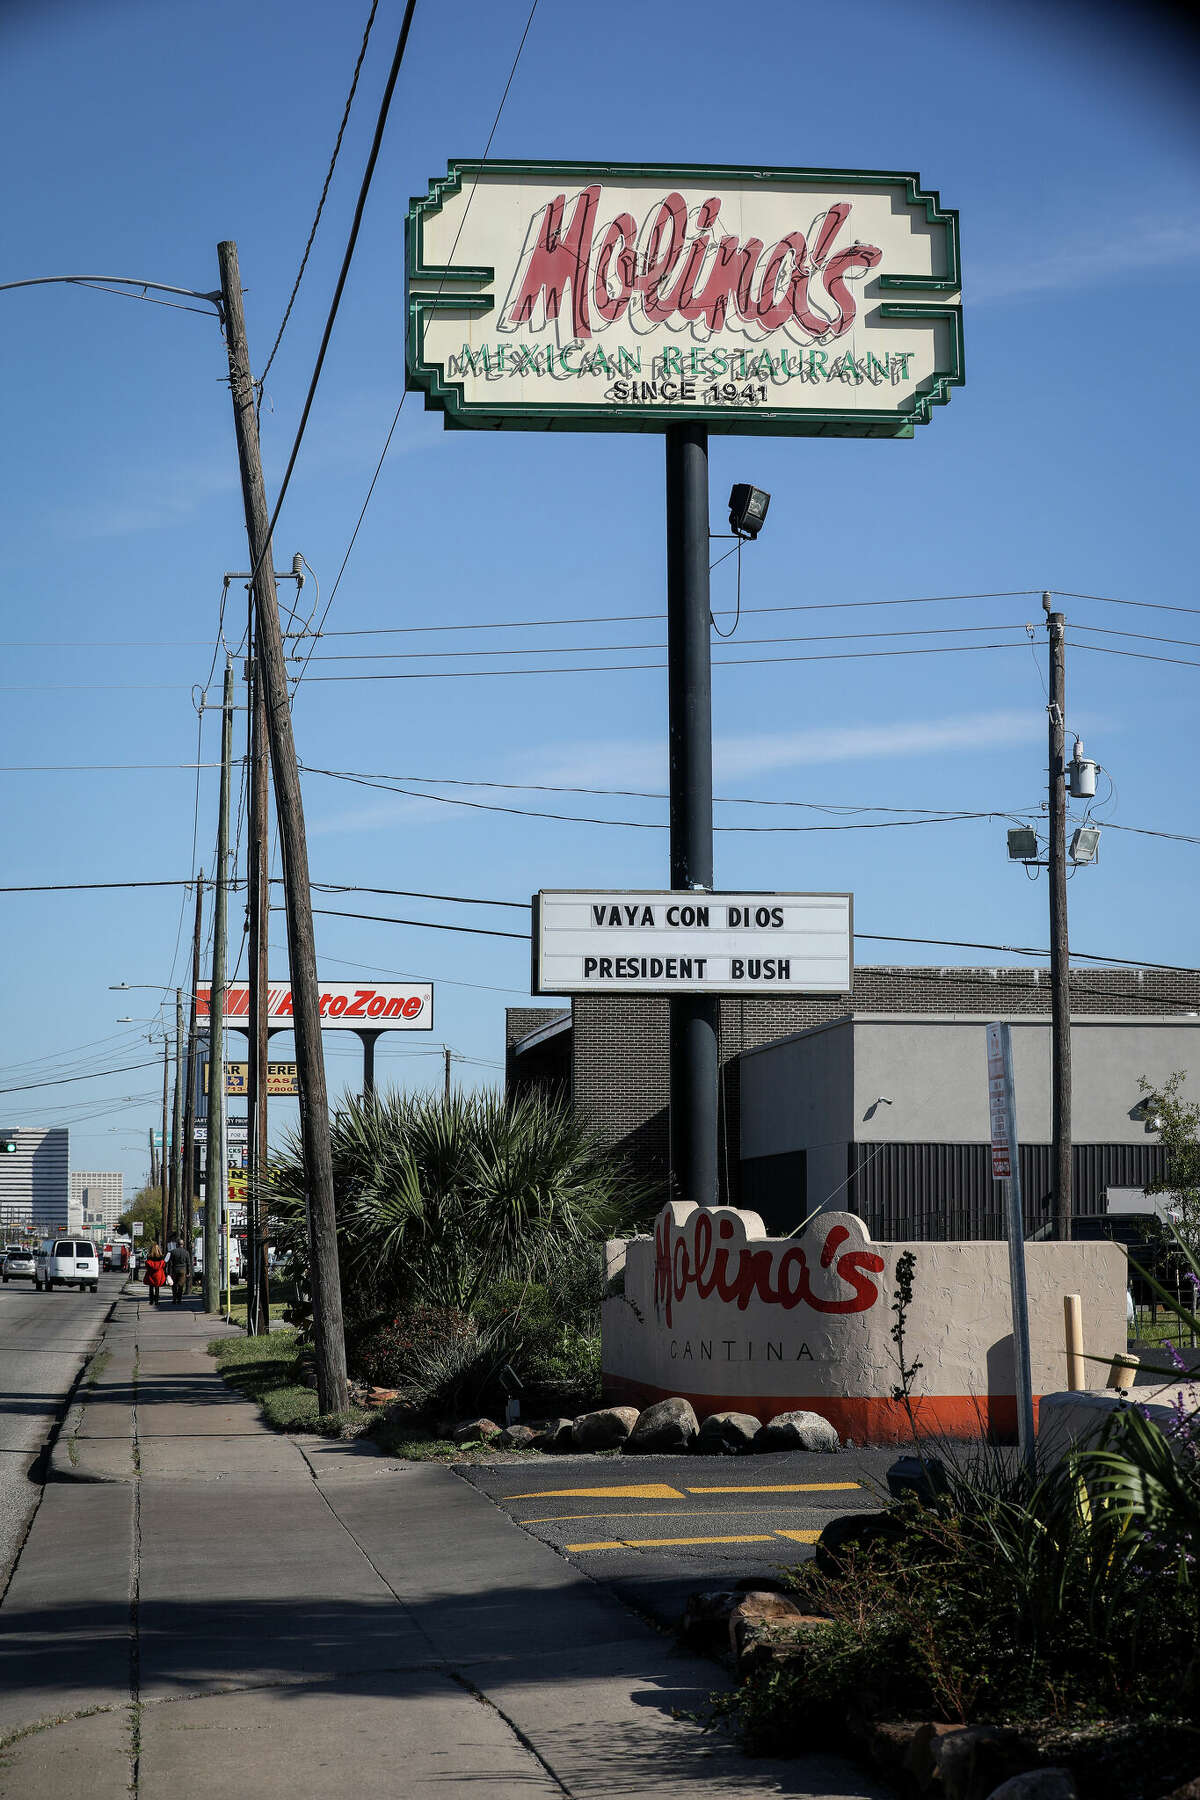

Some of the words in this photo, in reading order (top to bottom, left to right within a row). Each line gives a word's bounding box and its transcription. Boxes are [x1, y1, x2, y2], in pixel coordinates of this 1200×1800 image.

[509, 184, 882, 338] Molina's
[459, 343, 642, 374] MEXICAN
[663, 346, 915, 379] RESTAURANT
[613, 380, 696, 400] SINCE
[709, 382, 768, 401] 1941
[593, 905, 655, 926] VAYA
[666, 906, 709, 927] CON
[728, 907, 784, 928] DIOS
[584, 957, 707, 979] PRESIDENT
[732, 959, 790, 979] BUSH
[275, 990, 422, 1018] AtoZone
[267, 1066, 296, 1075] ERE
[654, 1211, 885, 1329] Molina's
[671, 1340, 814, 1361] CANTINA
